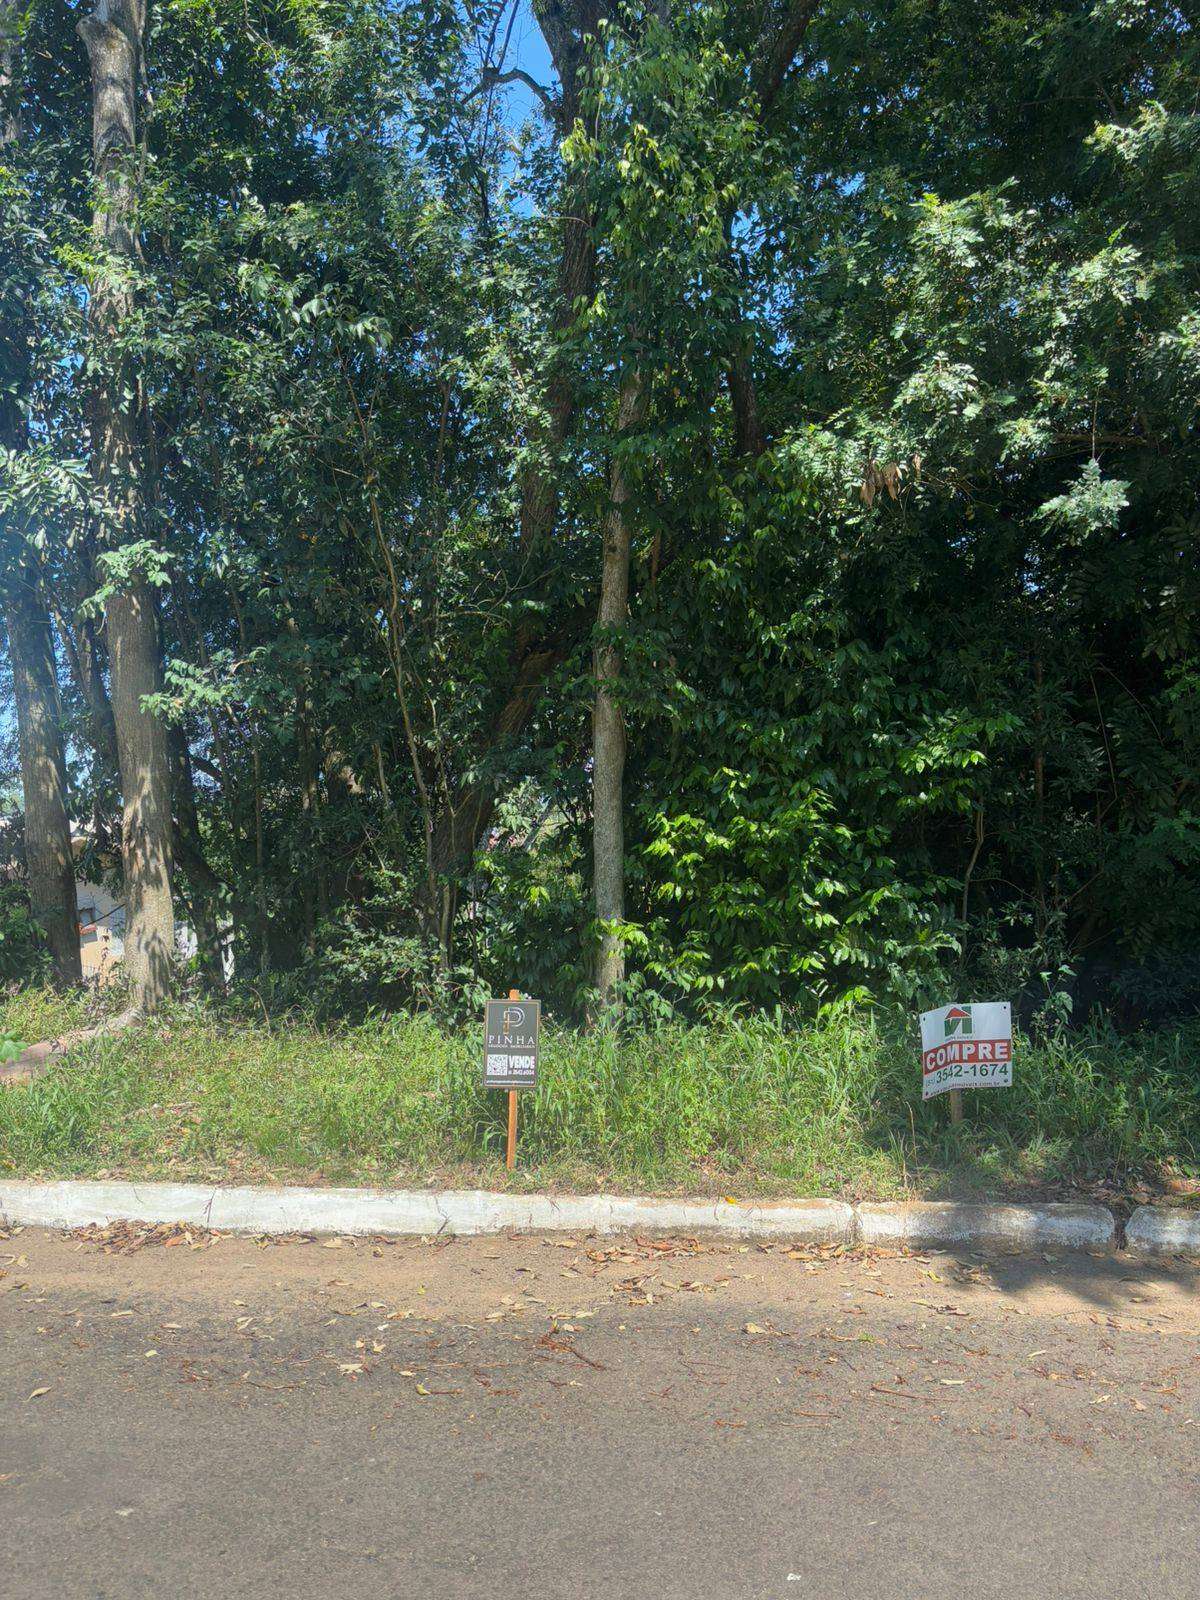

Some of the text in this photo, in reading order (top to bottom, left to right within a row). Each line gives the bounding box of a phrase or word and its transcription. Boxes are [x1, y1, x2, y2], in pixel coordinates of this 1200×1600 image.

[488, 1035, 535, 1045] PINHA
[509, 1055, 535, 1069] VENDE
[926, 1042, 1009, 1070] COMPRE
[936, 1063, 1008, 1083] 3542-1674
